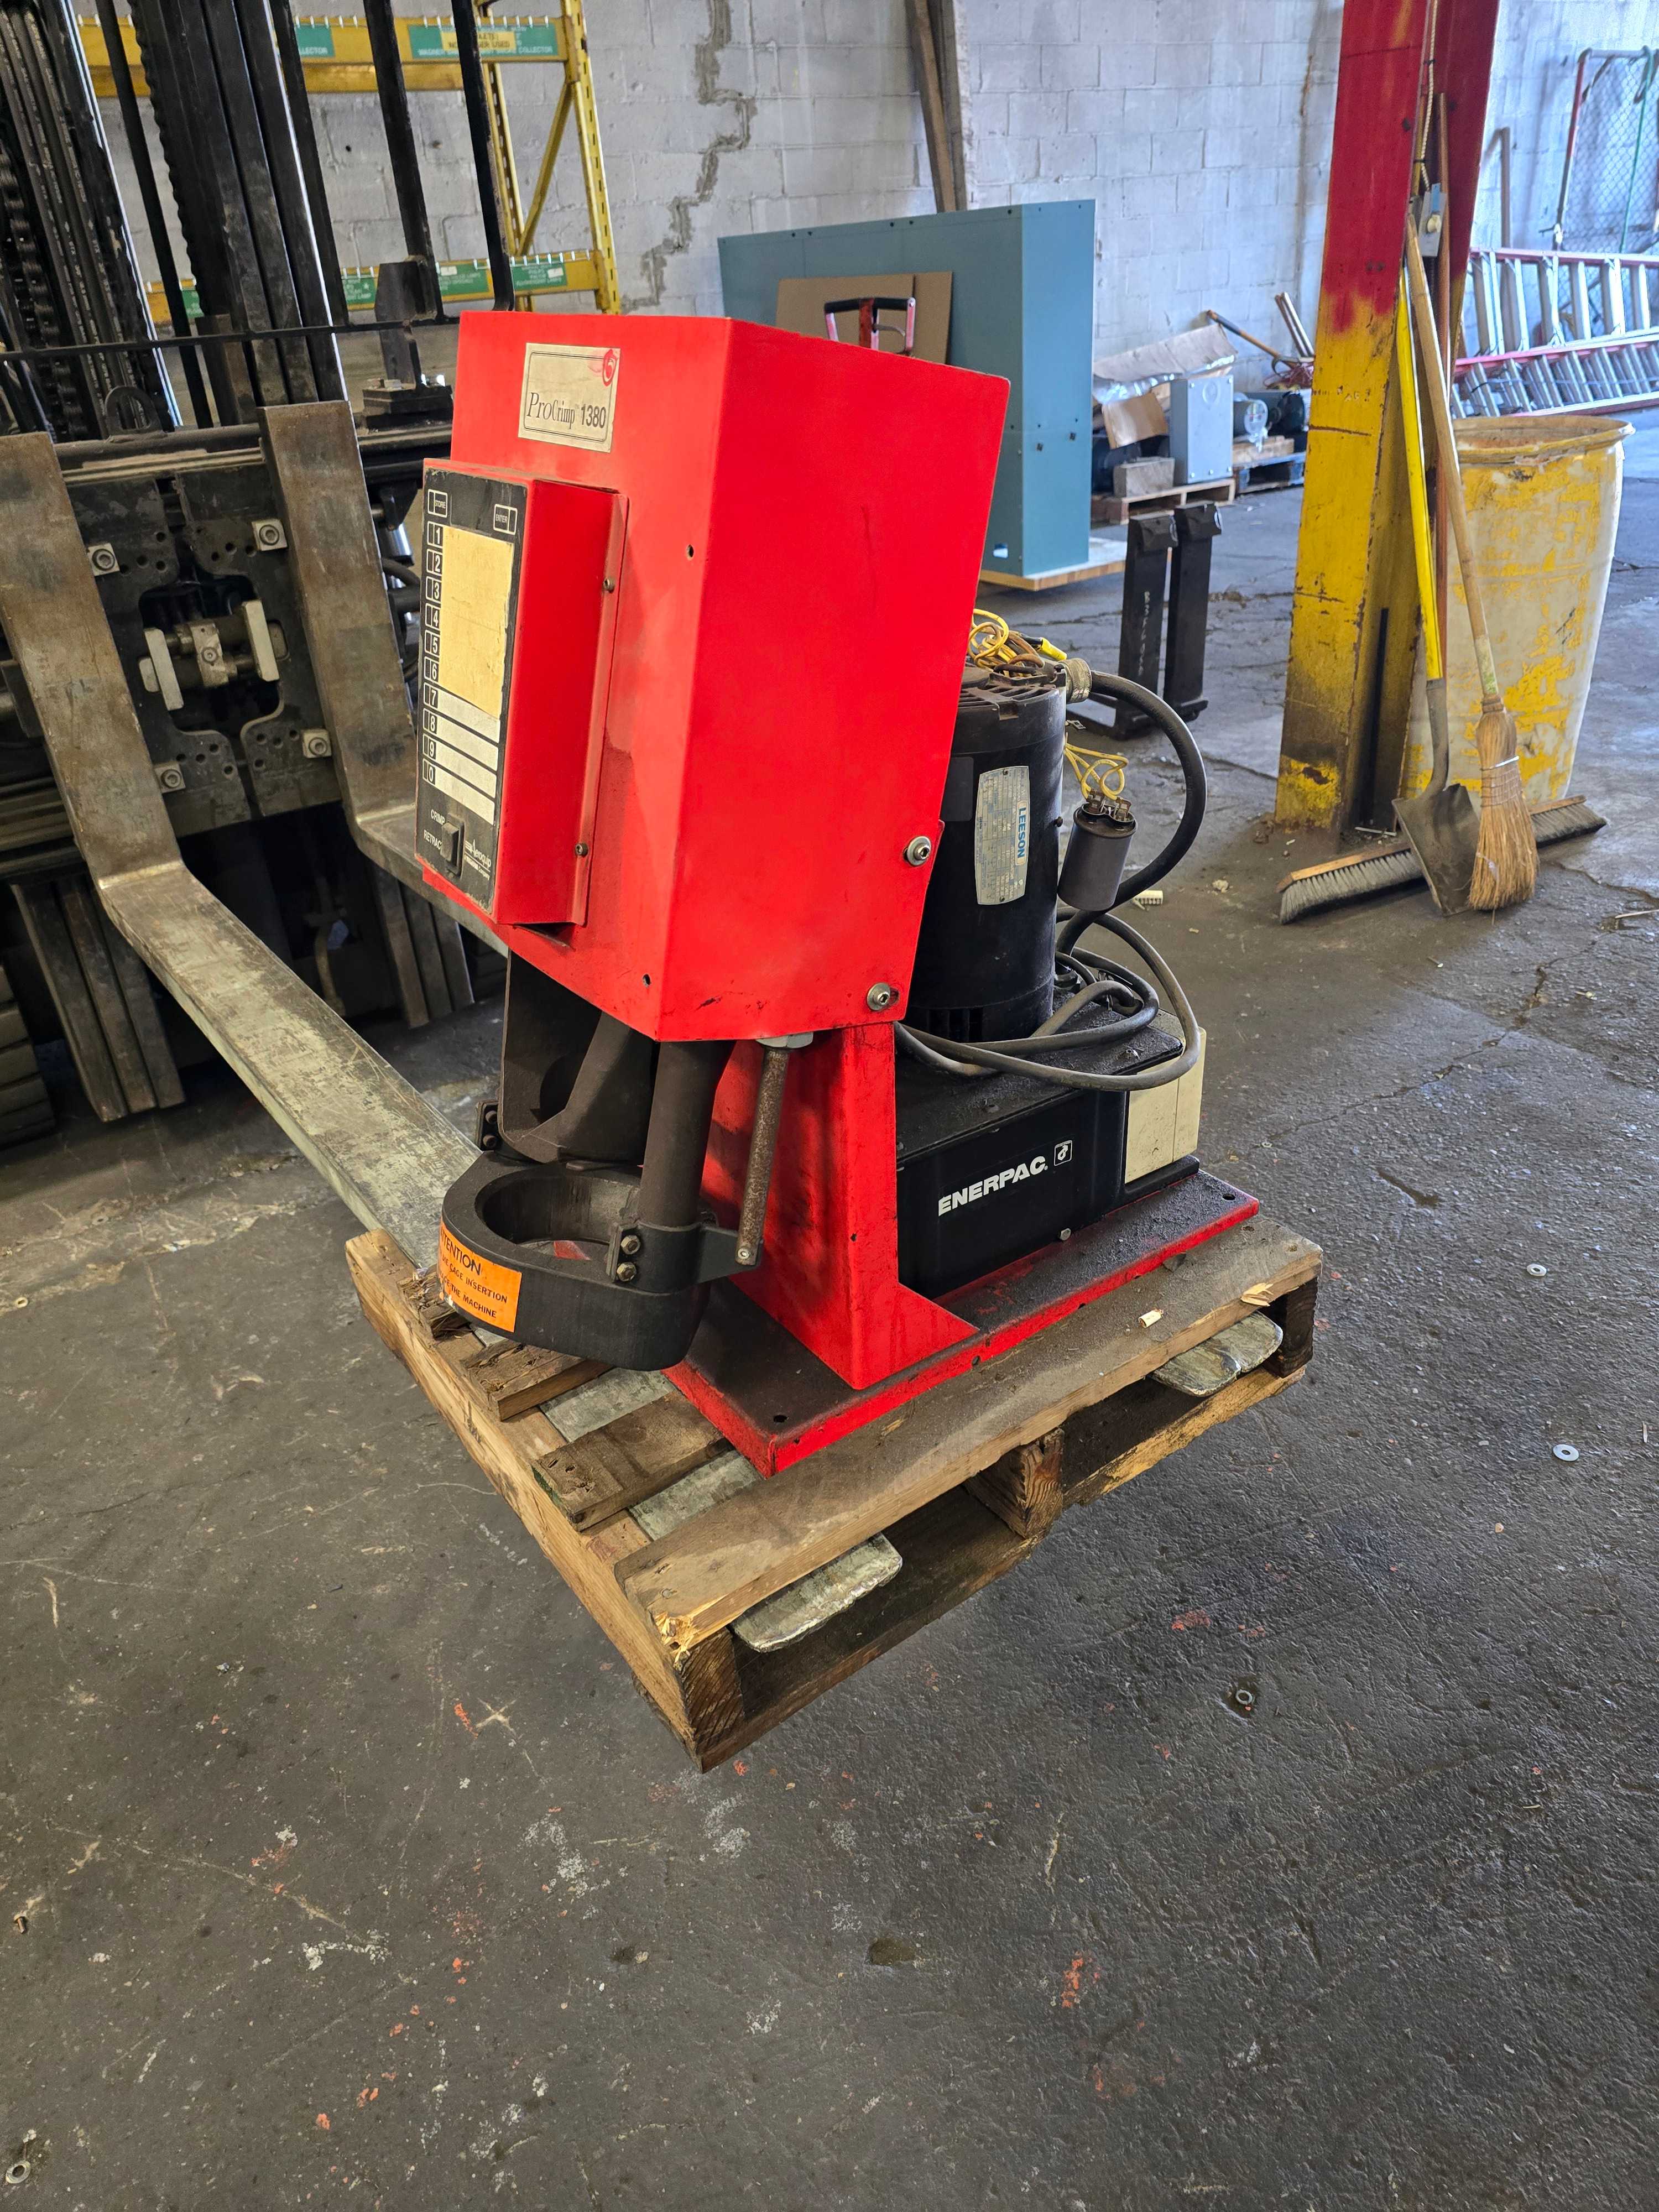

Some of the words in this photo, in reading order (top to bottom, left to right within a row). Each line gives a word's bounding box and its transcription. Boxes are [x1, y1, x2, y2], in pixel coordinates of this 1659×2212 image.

[526, 392, 575, 430] ProCrimp
[581, 404, 607, 429] 1380
[435, 499, 446, 509] STORE
[495, 514, 508, 523] ENTER
[436, 527, 441, 545] 1
[435, 555, 441, 573] 2
[434, 582, 440, 599] 3
[433, 610, 439, 627] 4
[432, 637, 438, 654] 5
[432, 663, 437, 680] 6
[431, 689, 437, 706] 7
[430, 715, 436, 732] 8
[430, 741, 435, 758] 9
[429, 766, 434, 782] 0
[431, 809, 446, 825] CRIMP
[424, 829, 442, 850] RETRAC
[1017, 807, 1027, 858] LEESON
[469, 839, 492, 869] Aeroquip
[466, 1276, 508, 1304] INSERTION
[463, 1294, 497, 1318] MACHINE
